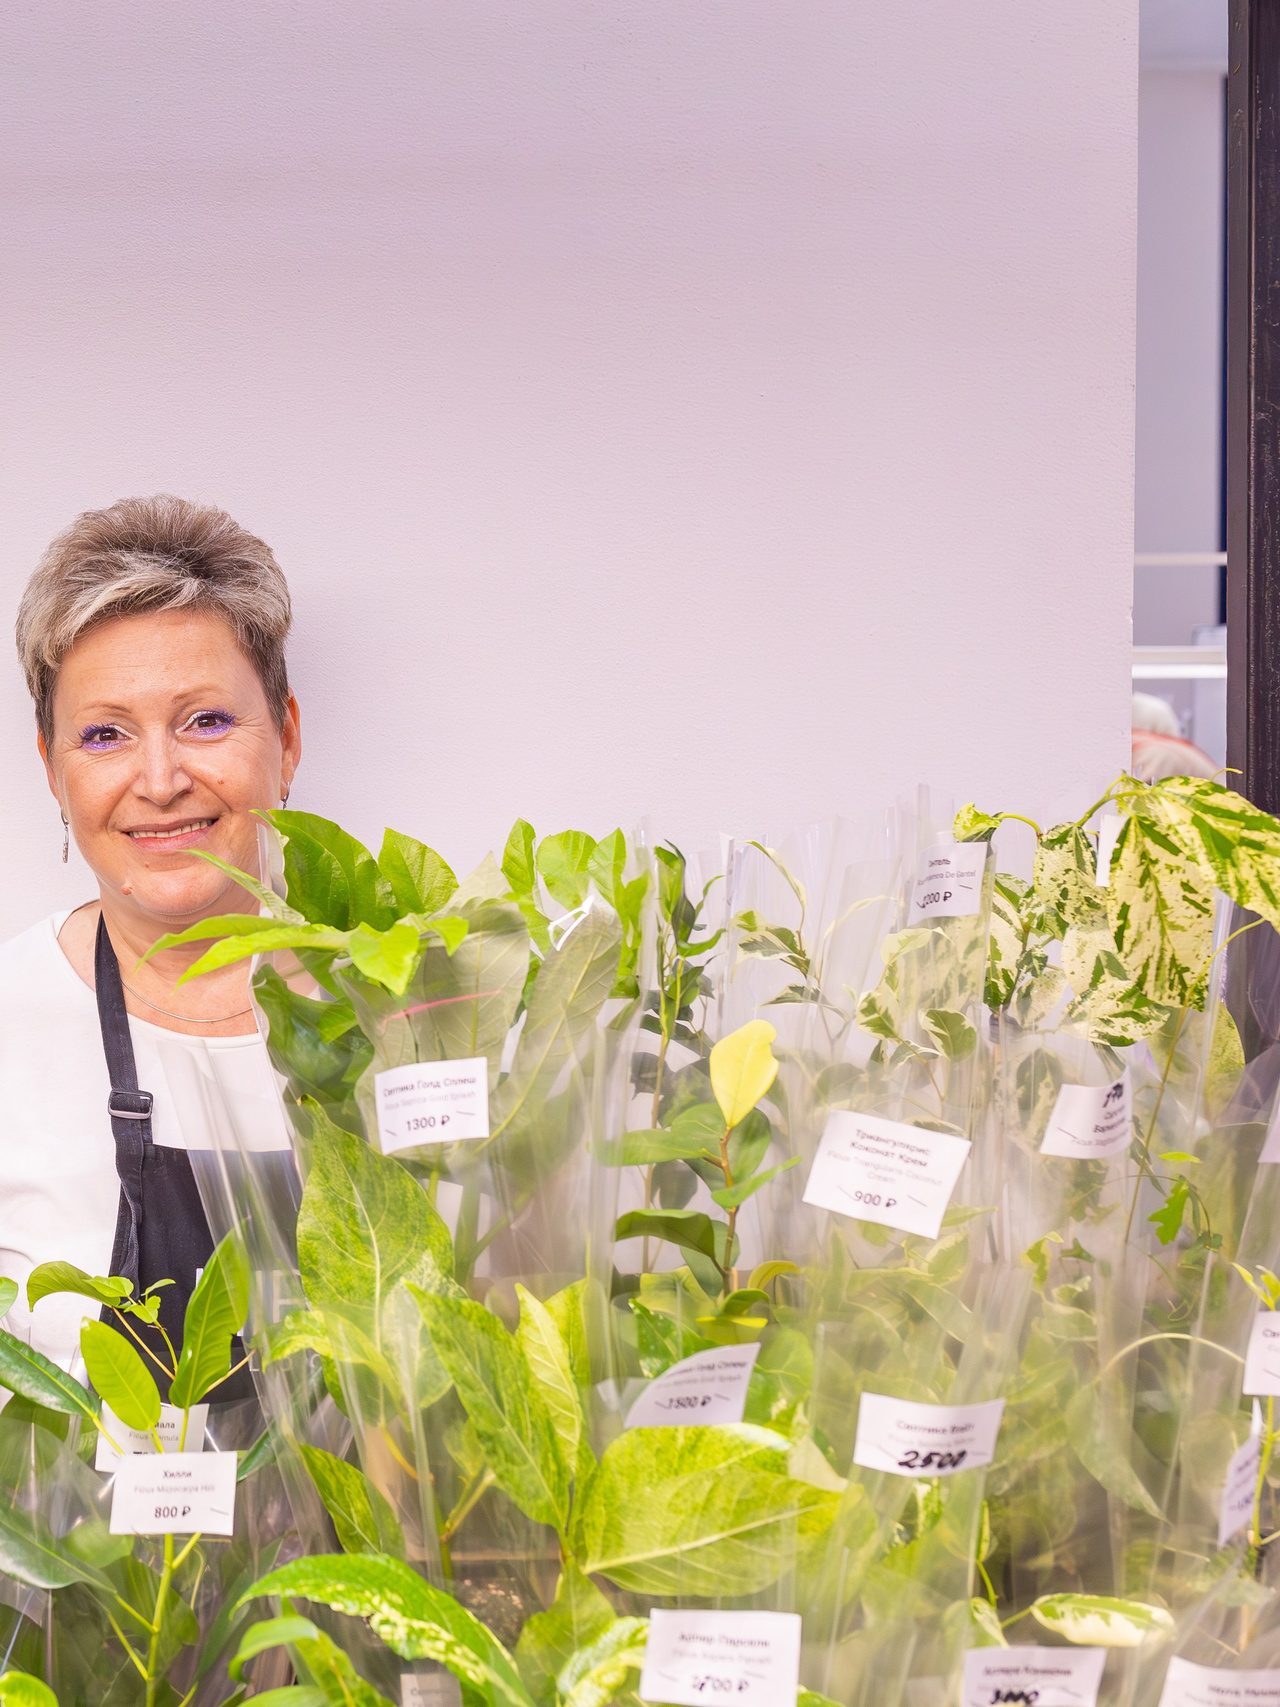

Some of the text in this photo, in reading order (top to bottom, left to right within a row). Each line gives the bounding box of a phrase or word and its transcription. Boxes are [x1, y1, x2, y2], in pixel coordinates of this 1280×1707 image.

[417, 1079, 441, 1091] Голд
[406, 1117, 436, 1131] 1300
[854, 1190, 881, 1206] 900
[898, 1450, 968, 1468] 2500
[154, 1507, 178, 1518] 800
